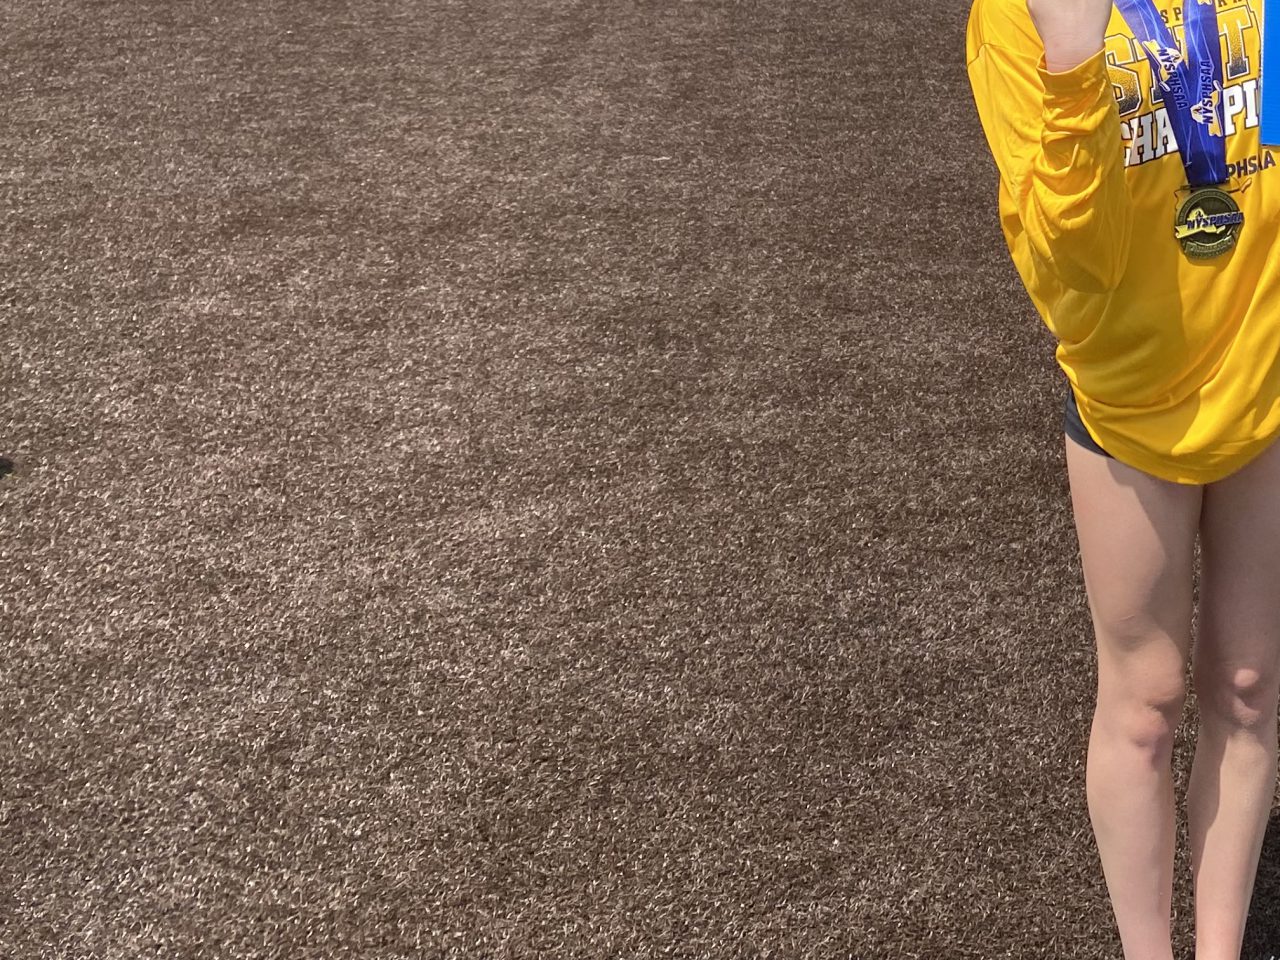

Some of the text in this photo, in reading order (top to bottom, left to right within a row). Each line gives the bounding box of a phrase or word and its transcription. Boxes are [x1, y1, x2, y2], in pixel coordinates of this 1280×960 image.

[1157, 47, 1190, 111] NYSPHSAA
[1200, 59, 1214, 124] NYSPHSAA
[1186, 211, 1245, 230] NYSPHSAA
